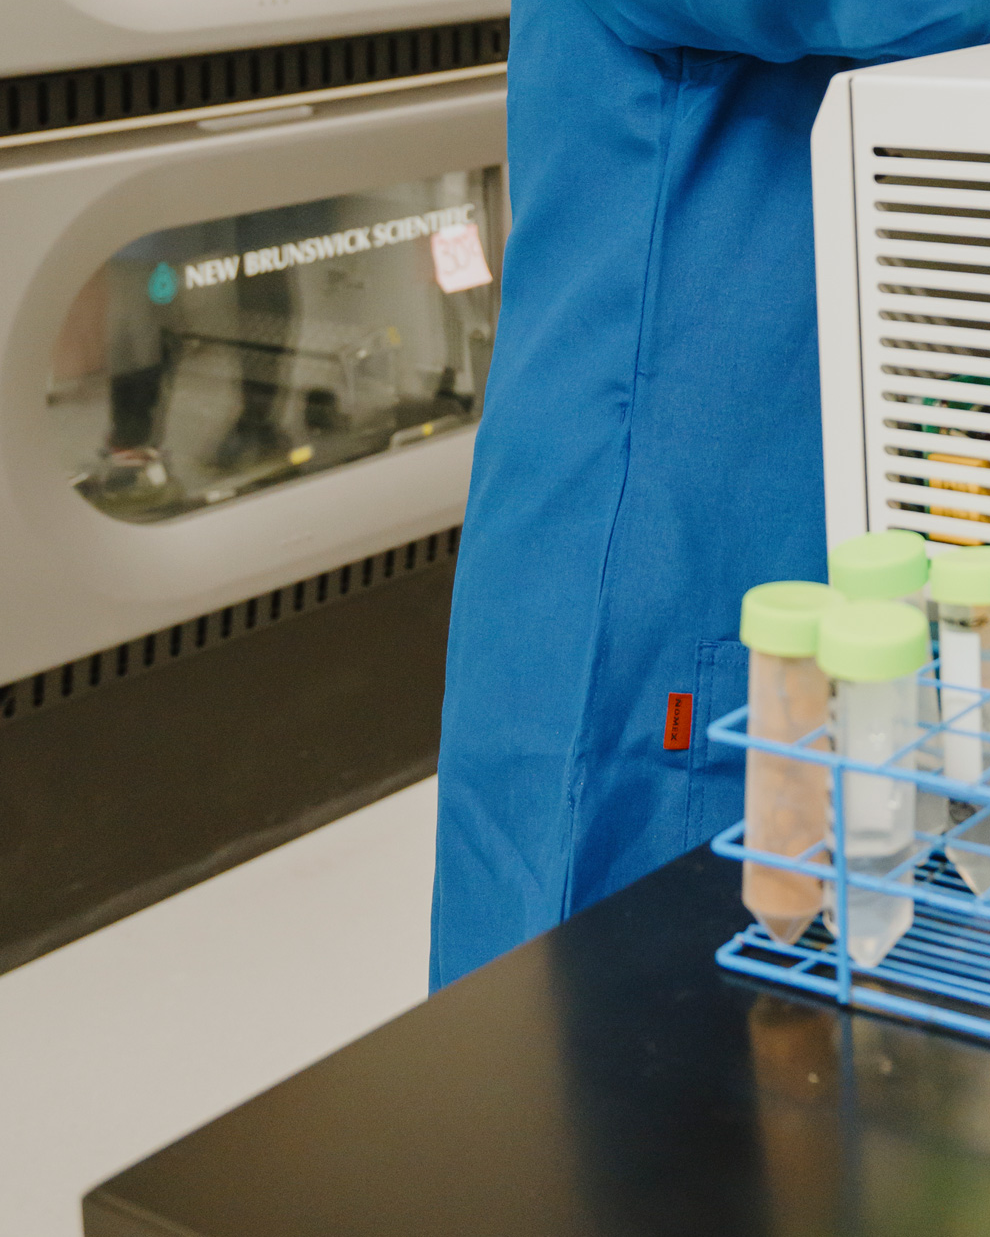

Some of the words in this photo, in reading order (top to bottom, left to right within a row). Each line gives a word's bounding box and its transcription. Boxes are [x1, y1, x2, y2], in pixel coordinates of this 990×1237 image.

[184, 255, 240, 290] NEW
[243, 226, 371, 278] BRUNSWICK
[373, 203, 475, 249] SCIENTIFIC
[670, 698, 682, 742] NOMEX
